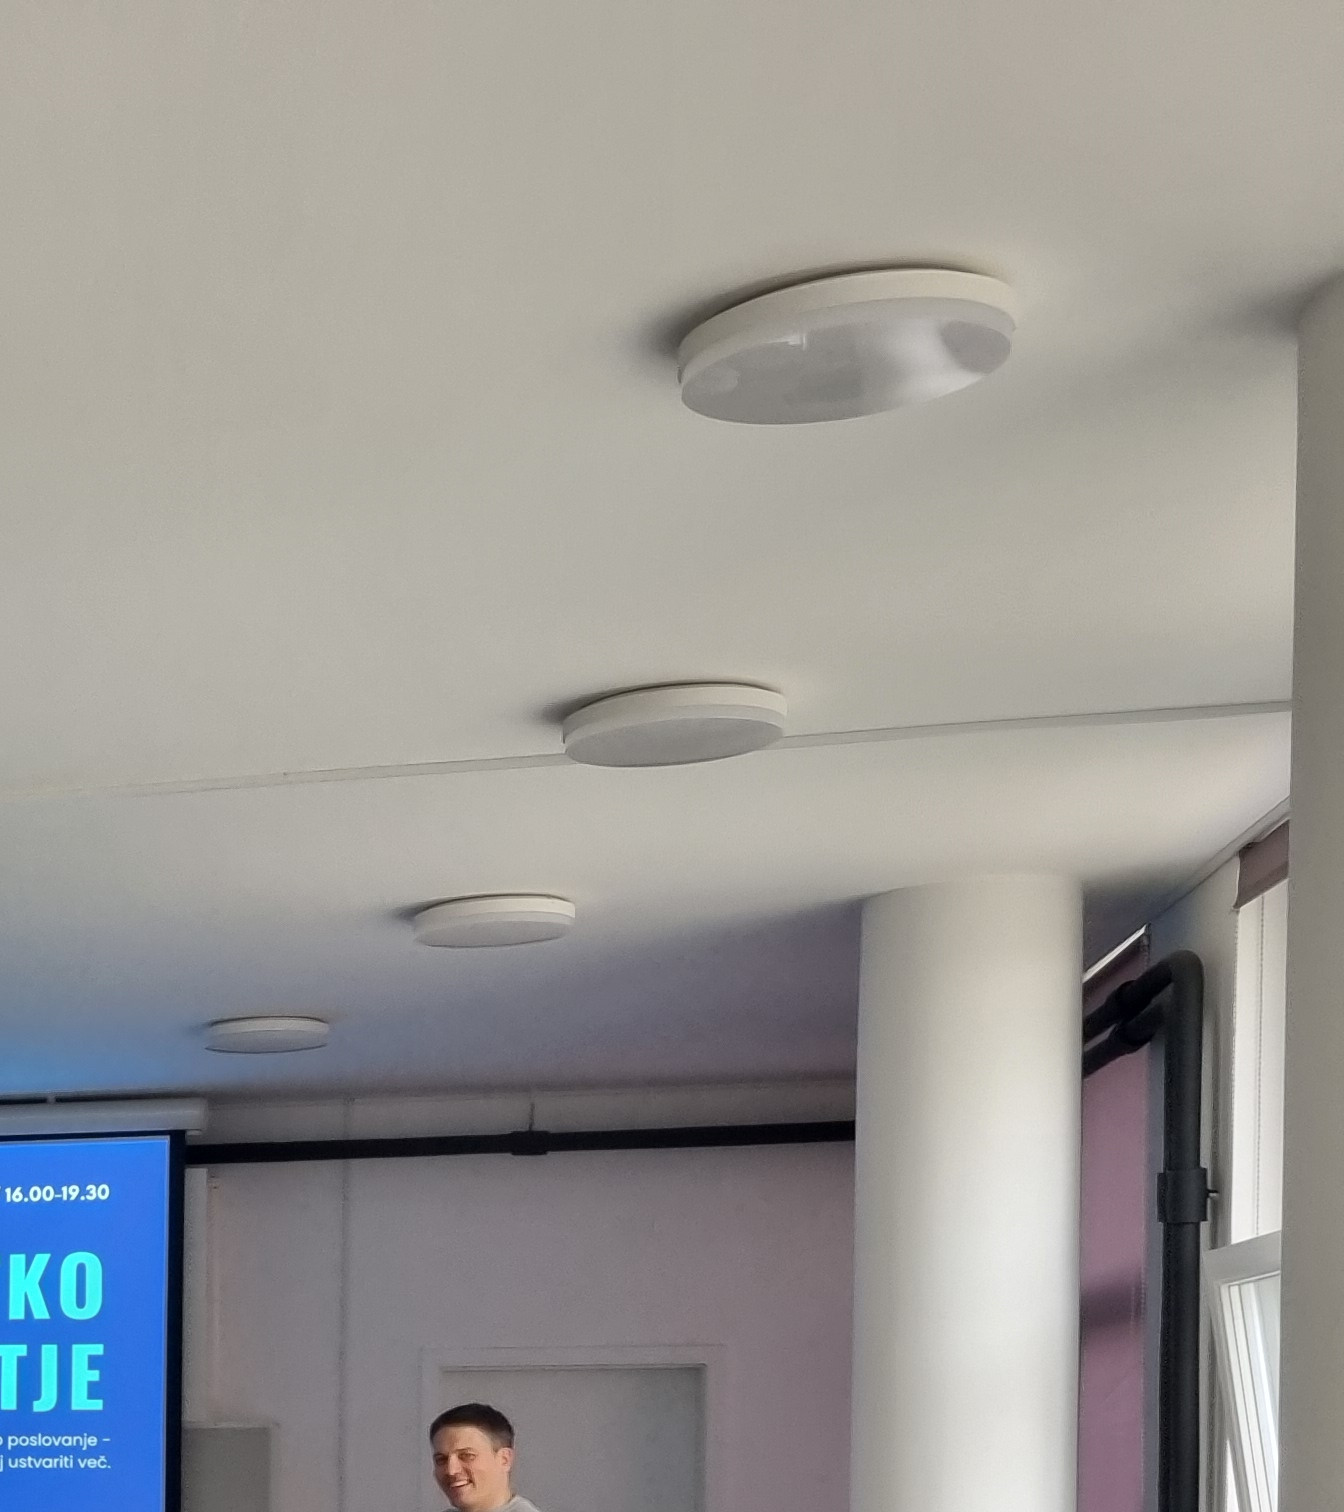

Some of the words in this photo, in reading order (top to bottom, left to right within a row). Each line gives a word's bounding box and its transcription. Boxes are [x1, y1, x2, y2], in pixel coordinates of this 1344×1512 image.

[4, 1183, 110, 1203] 16.00-19.30
[7, 1432, 98, 1451] poslovanje
[8, 1454, 74, 1469] ustvariti
[77, 1455, 112, 1469] več.
